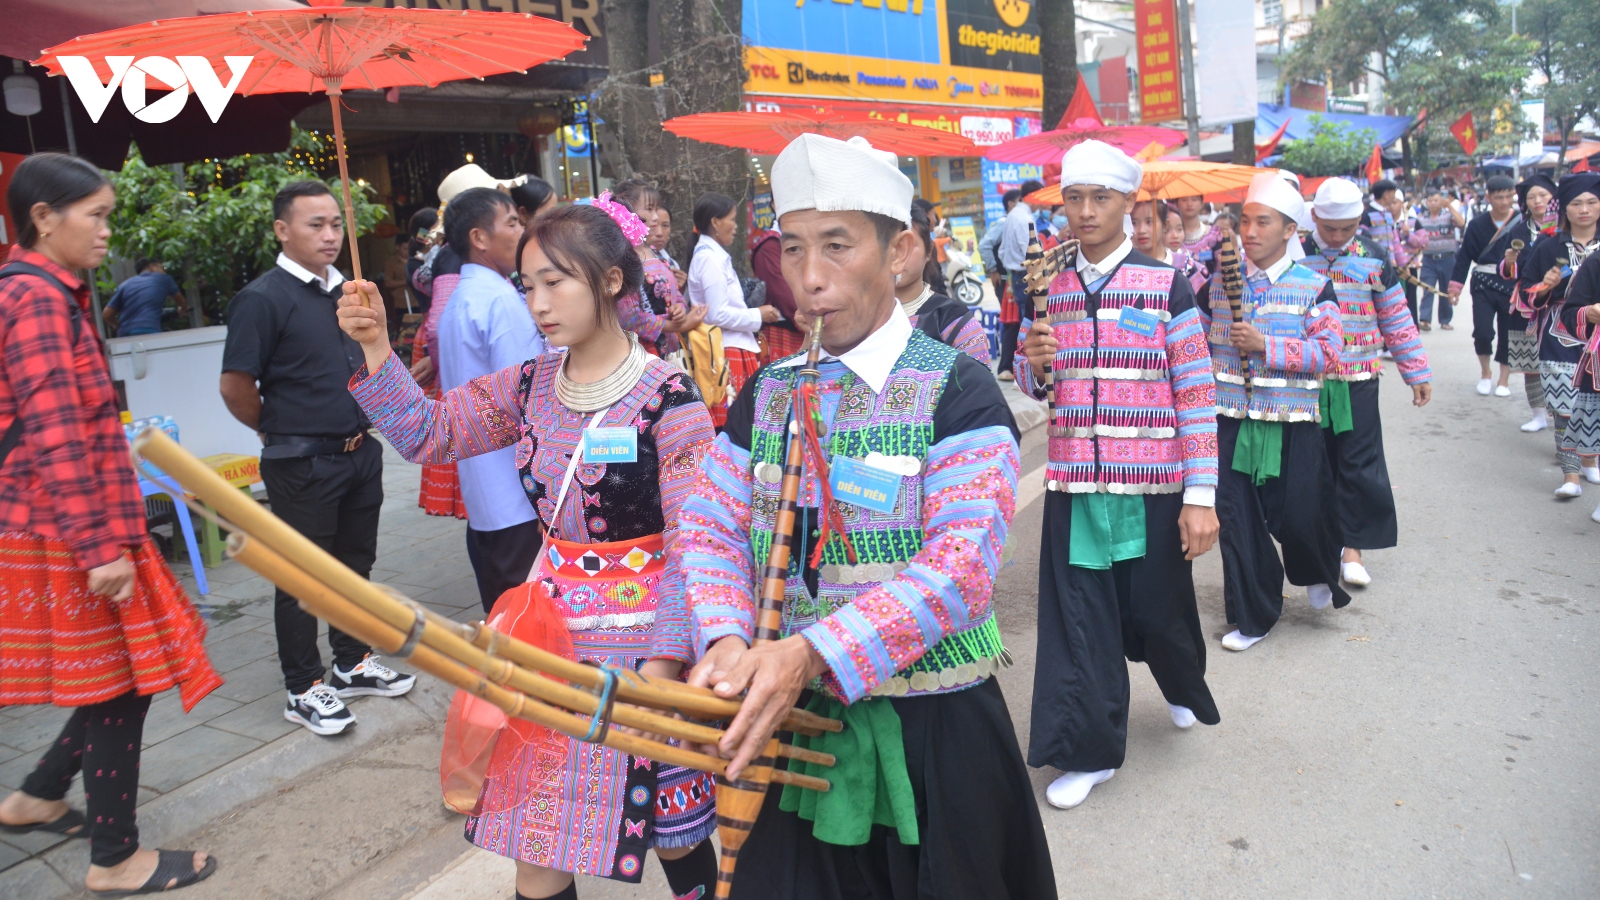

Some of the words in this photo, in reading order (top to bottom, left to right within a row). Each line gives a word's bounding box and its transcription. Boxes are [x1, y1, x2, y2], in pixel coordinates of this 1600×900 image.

[751, 64, 780, 79] TCL
[806, 68, 851, 83] Electrolux
[857, 71, 906, 88] Panasonic
[912, 77, 939, 90] AQUA
[1004, 84, 1040, 98] TOSHIBA
[590, 444, 609, 456] DIỄN
[611, 444, 629, 455] VIÊN
[224, 465, 239, 480] HÀ
[837, 480, 861, 495] DIỄN
[863, 488, 887, 503] VIÊN
